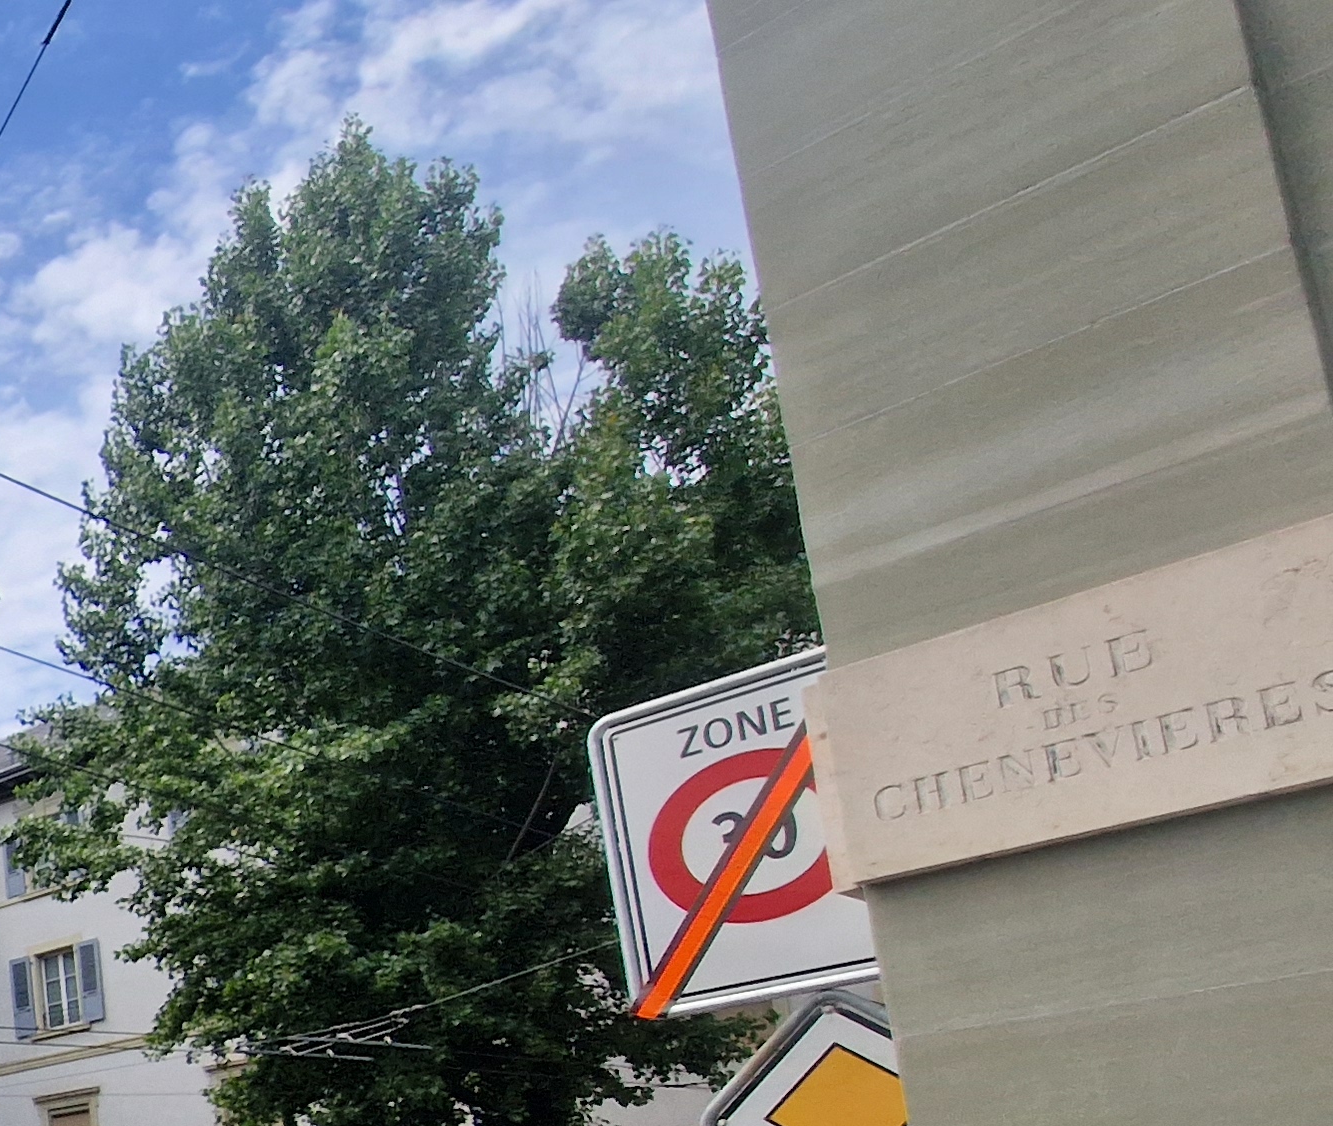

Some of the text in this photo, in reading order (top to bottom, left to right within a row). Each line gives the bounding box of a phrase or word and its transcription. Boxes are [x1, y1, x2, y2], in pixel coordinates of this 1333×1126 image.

[992, 628, 1155, 709] RUE
[676, 696, 796, 759] ZONE
[1042, 693, 1118, 732] DES
